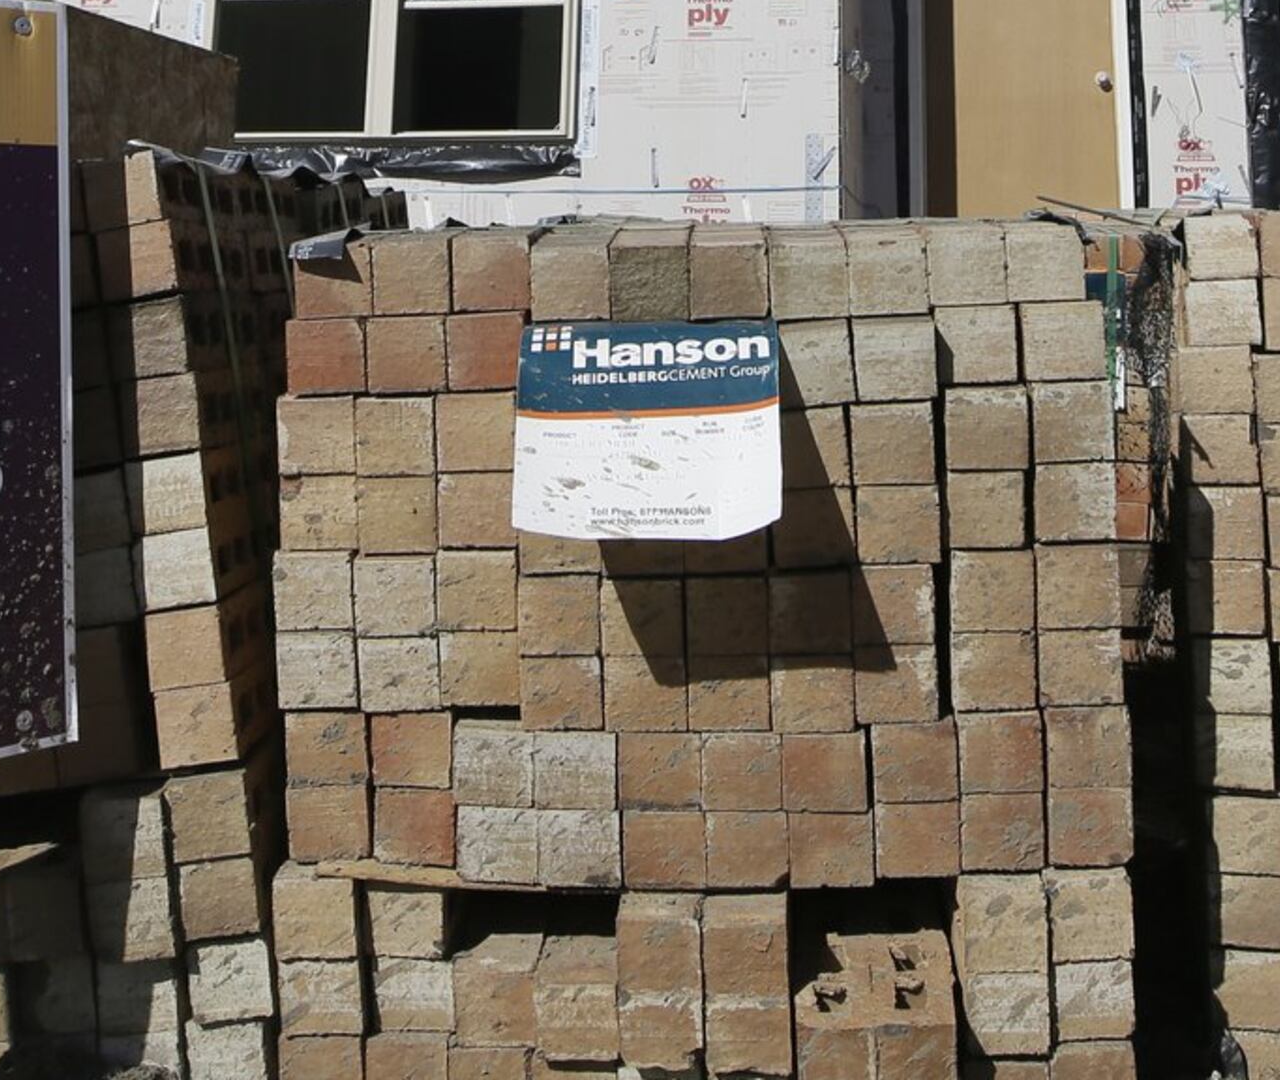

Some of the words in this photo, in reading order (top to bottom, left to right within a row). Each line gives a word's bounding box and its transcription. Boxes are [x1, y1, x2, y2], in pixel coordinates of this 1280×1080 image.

[688, 3, 730, 26] ply
[573, 335, 770, 369] Hanson
[572, 367, 725, 385] HEIDELBERGCEMENT
[730, 364, 770, 380] Group
